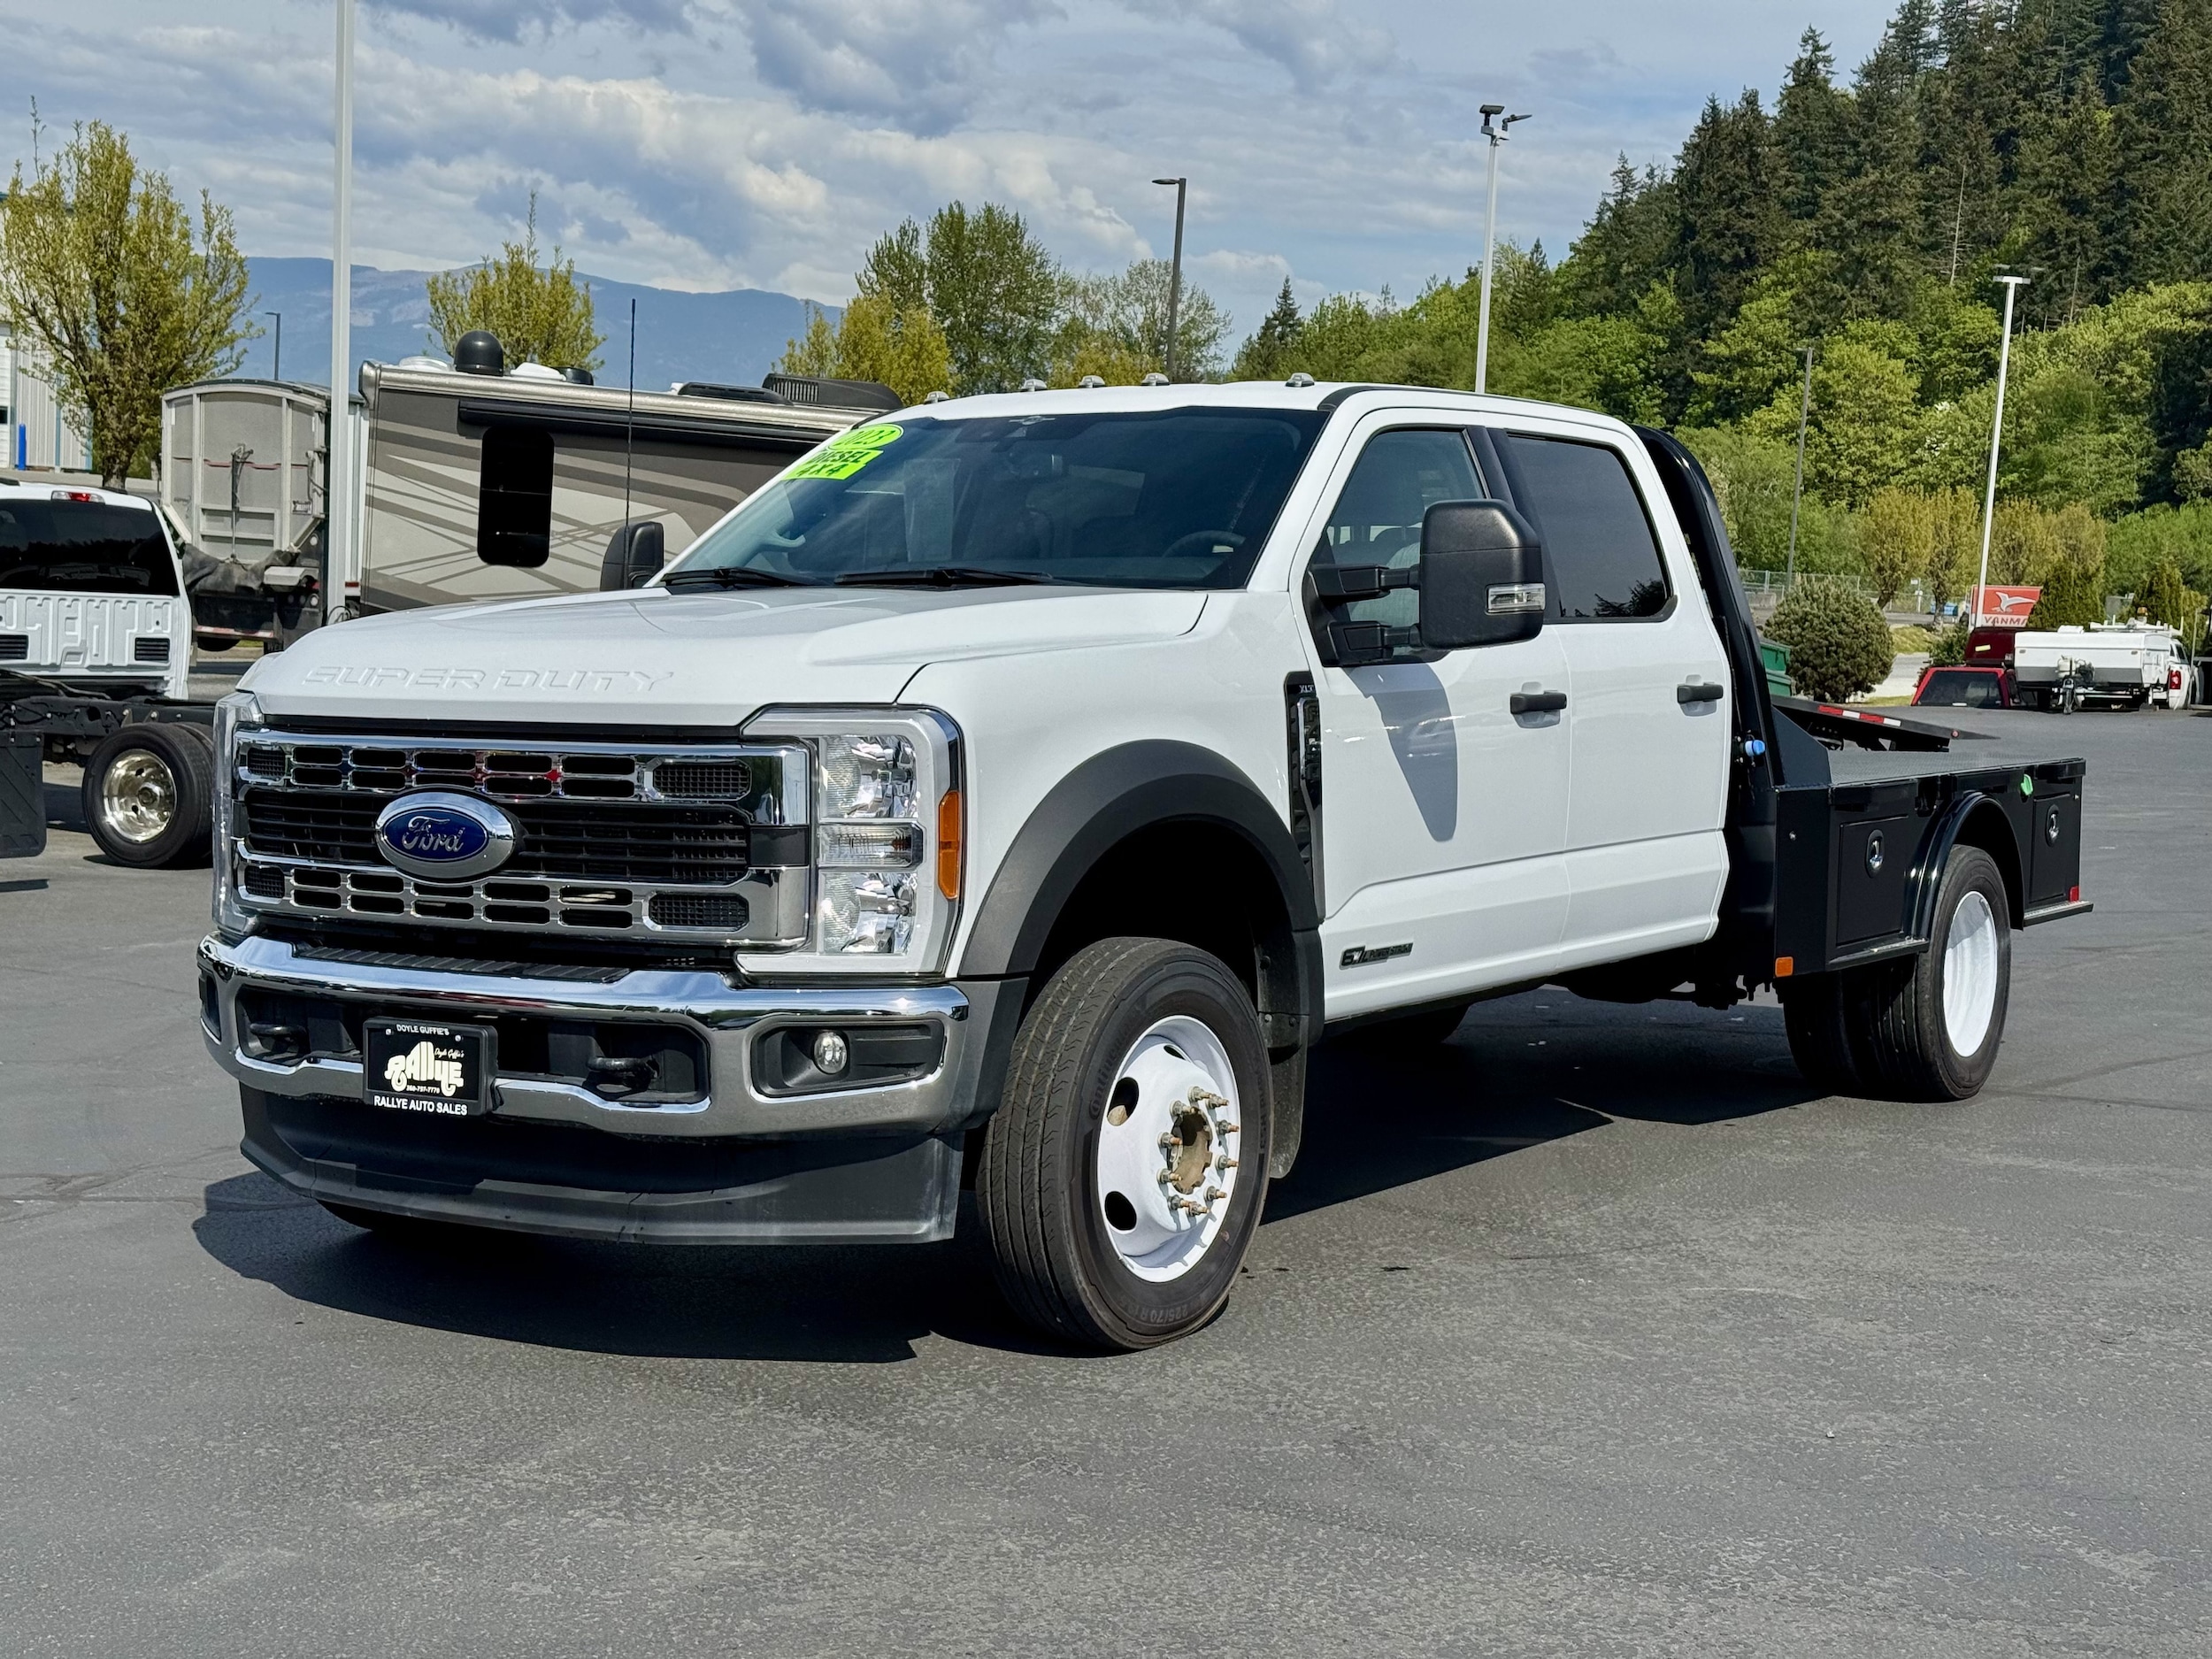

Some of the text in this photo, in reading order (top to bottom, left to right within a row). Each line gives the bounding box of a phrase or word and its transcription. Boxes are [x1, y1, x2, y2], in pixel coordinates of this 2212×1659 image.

[804, 450, 872, 465] DIESEL
[302, 665, 674, 692] SUPER DUTY
[1299, 684, 1315, 694] XLT
[402, 815, 466, 852] Ford
[396, 1024, 449, 1036] DOYLE GUFFIE'S
[373, 1095, 468, 1116] RALLYE AUTO SALES
[1149, 1303, 1188, 1324] 225/70
